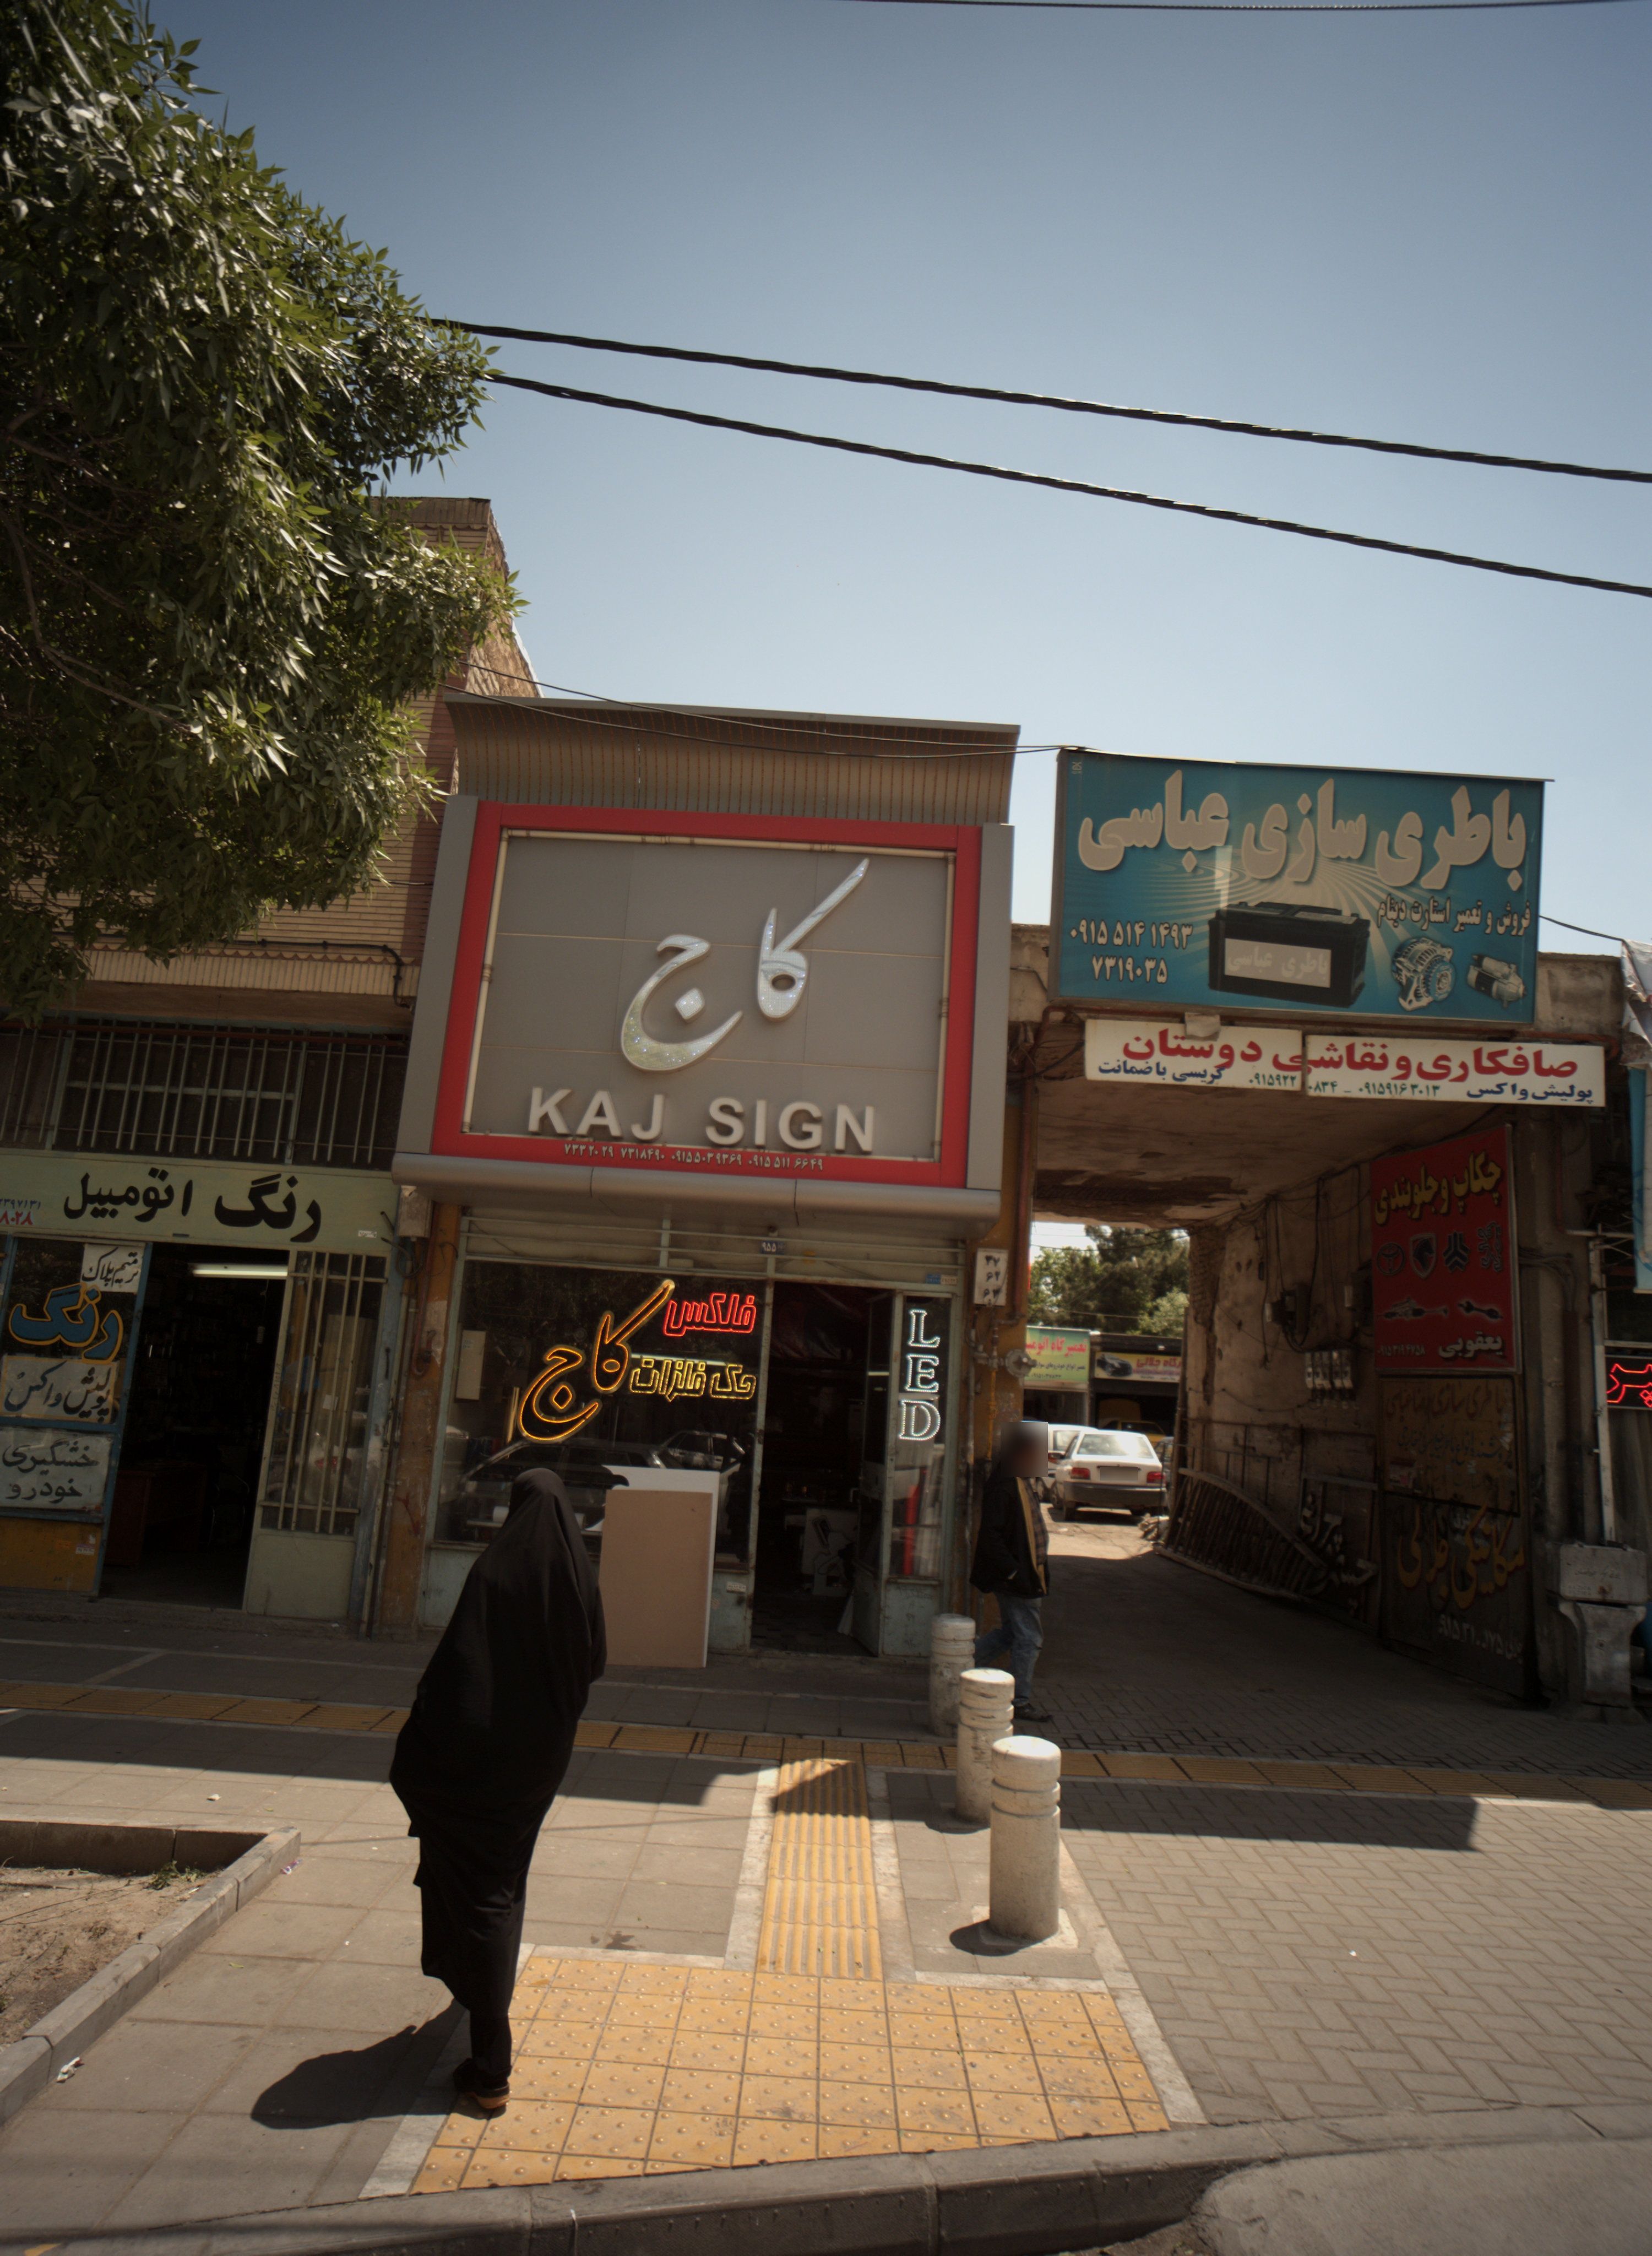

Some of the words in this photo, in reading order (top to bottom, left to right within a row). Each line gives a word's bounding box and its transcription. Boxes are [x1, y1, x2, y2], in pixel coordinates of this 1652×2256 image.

[1078, 769, 1229, 872] عباسی
[1242, 778, 1367, 883] سازی
[1375, 785, 1527, 891] باطری
[1377, 893, 1407, 929] دینام
[1410, 896, 1452, 931] استارت
[1452, 899, 1482, 933] تعمیر
[1484, 910, 1493, 935] و
[1496, 899, 1531, 936] فروش
[1070, 918, 1108, 945] ۰۹۱۵
[1112, 920, 1145, 947] ۵۱۴
[1151, 921, 1194, 950] ۱۴۹۳
[621, 857, 870, 1072] کاج
[1091, 954, 1168, 985] ۷۳۱۹۰۳۵
[1227, 945, 1273, 974] عباسی
[1122, 1028, 1263, 1070] دوستان
[1416, 1045, 1578, 1083] صافکاری
[528, 1086, 665, 1143] KAJ
[705, 1097, 875, 1153] SIGN
[63, 1167, 193, 1222] اتومبیل
[215, 1173, 321, 1243] رنگ
[8, 1282, 124, 1364] رنگ
[518, 1279, 676, 1442] کاج
[1438, 1331, 1504, 1359] یعقوبی
